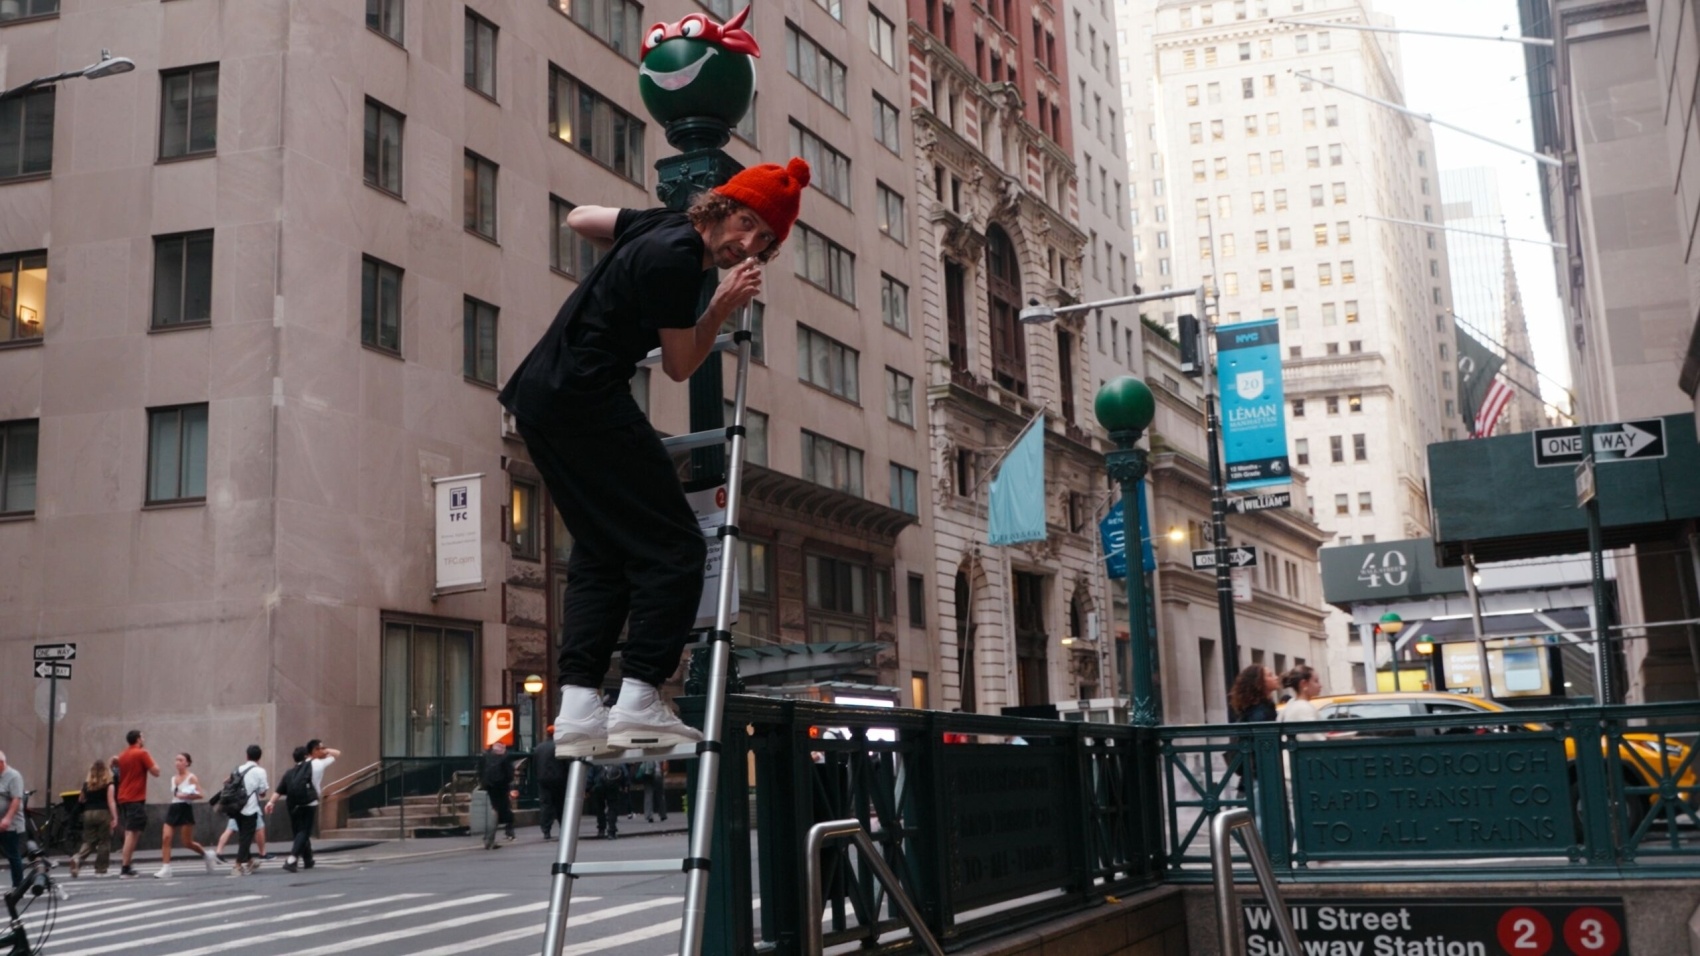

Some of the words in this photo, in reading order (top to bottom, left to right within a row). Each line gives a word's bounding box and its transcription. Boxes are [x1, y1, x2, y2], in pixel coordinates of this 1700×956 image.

[1235, 332, 1259, 343] NYC
[1243, 379, 1259, 390] 20
[1549, 437, 1582, 454] ONE
[1600, 432, 1637, 449] WAY
[1244, 496, 1283, 510] WILLIAM
[450, 511, 468, 522] TFC
[1357, 550, 1408, 588] 40
[1305, 748, 1551, 780] INTERBOROUGH
[1309, 788, 1380, 811] RAPID
[1389, 785, 1498, 809] TRANSIT
[1509, 783, 1552, 806] CO
[1312, 820, 1353, 844] TO
[1378, 819, 1428, 843] ALL
[1447, 816, 1556, 842] TRAINS
[1245, 906, 1308, 930] Wll
[1317, 906, 1412, 931] Street
[1247, 934, 1364, 956] Suway
[1373, 934, 1486, 956] Station
[1513, 918, 1538, 949] 2
[1579, 918, 1606, 949] 3
